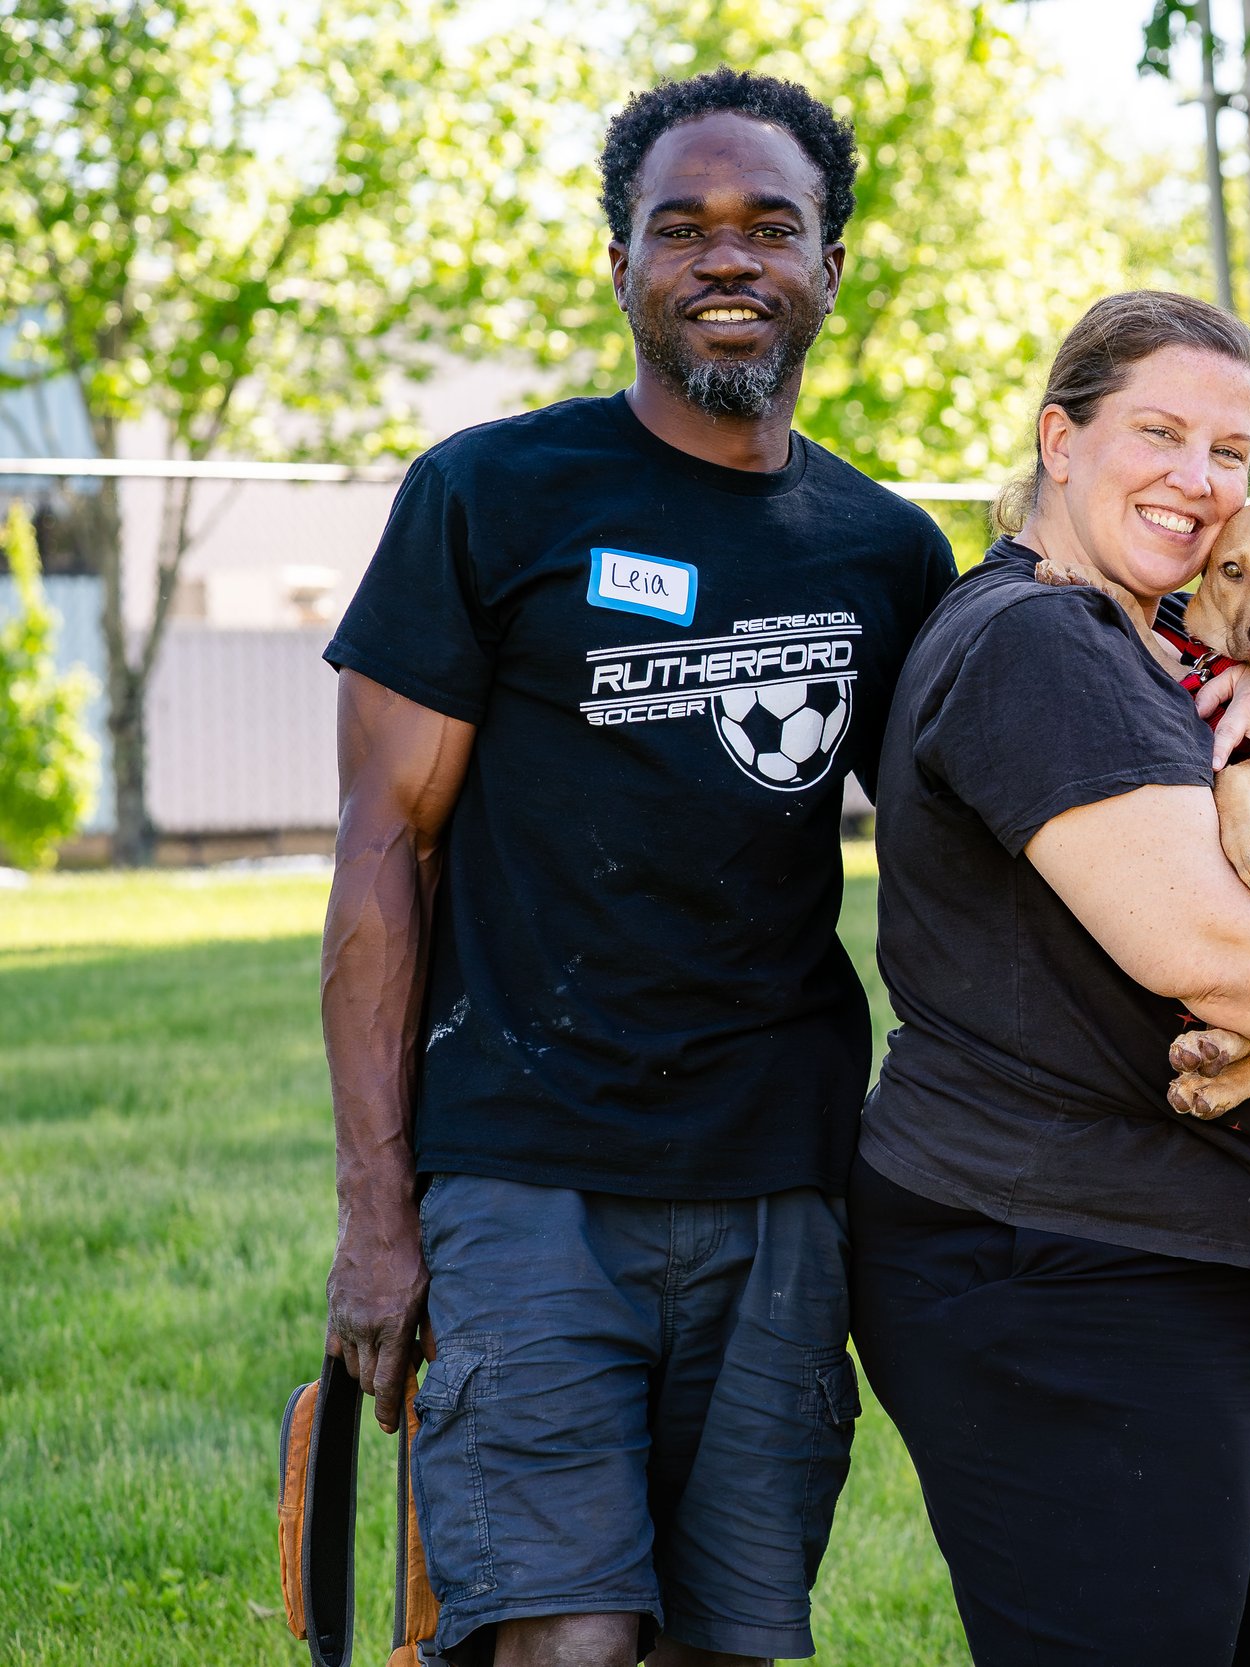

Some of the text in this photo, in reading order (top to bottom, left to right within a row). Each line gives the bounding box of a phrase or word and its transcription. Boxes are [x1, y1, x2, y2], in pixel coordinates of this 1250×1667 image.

[611, 562, 669, 597] Leia
[733, 611, 855, 634] RECREATION
[592, 640, 852, 694] RUTHERFORD
[586, 700, 705, 726] SOCCER
